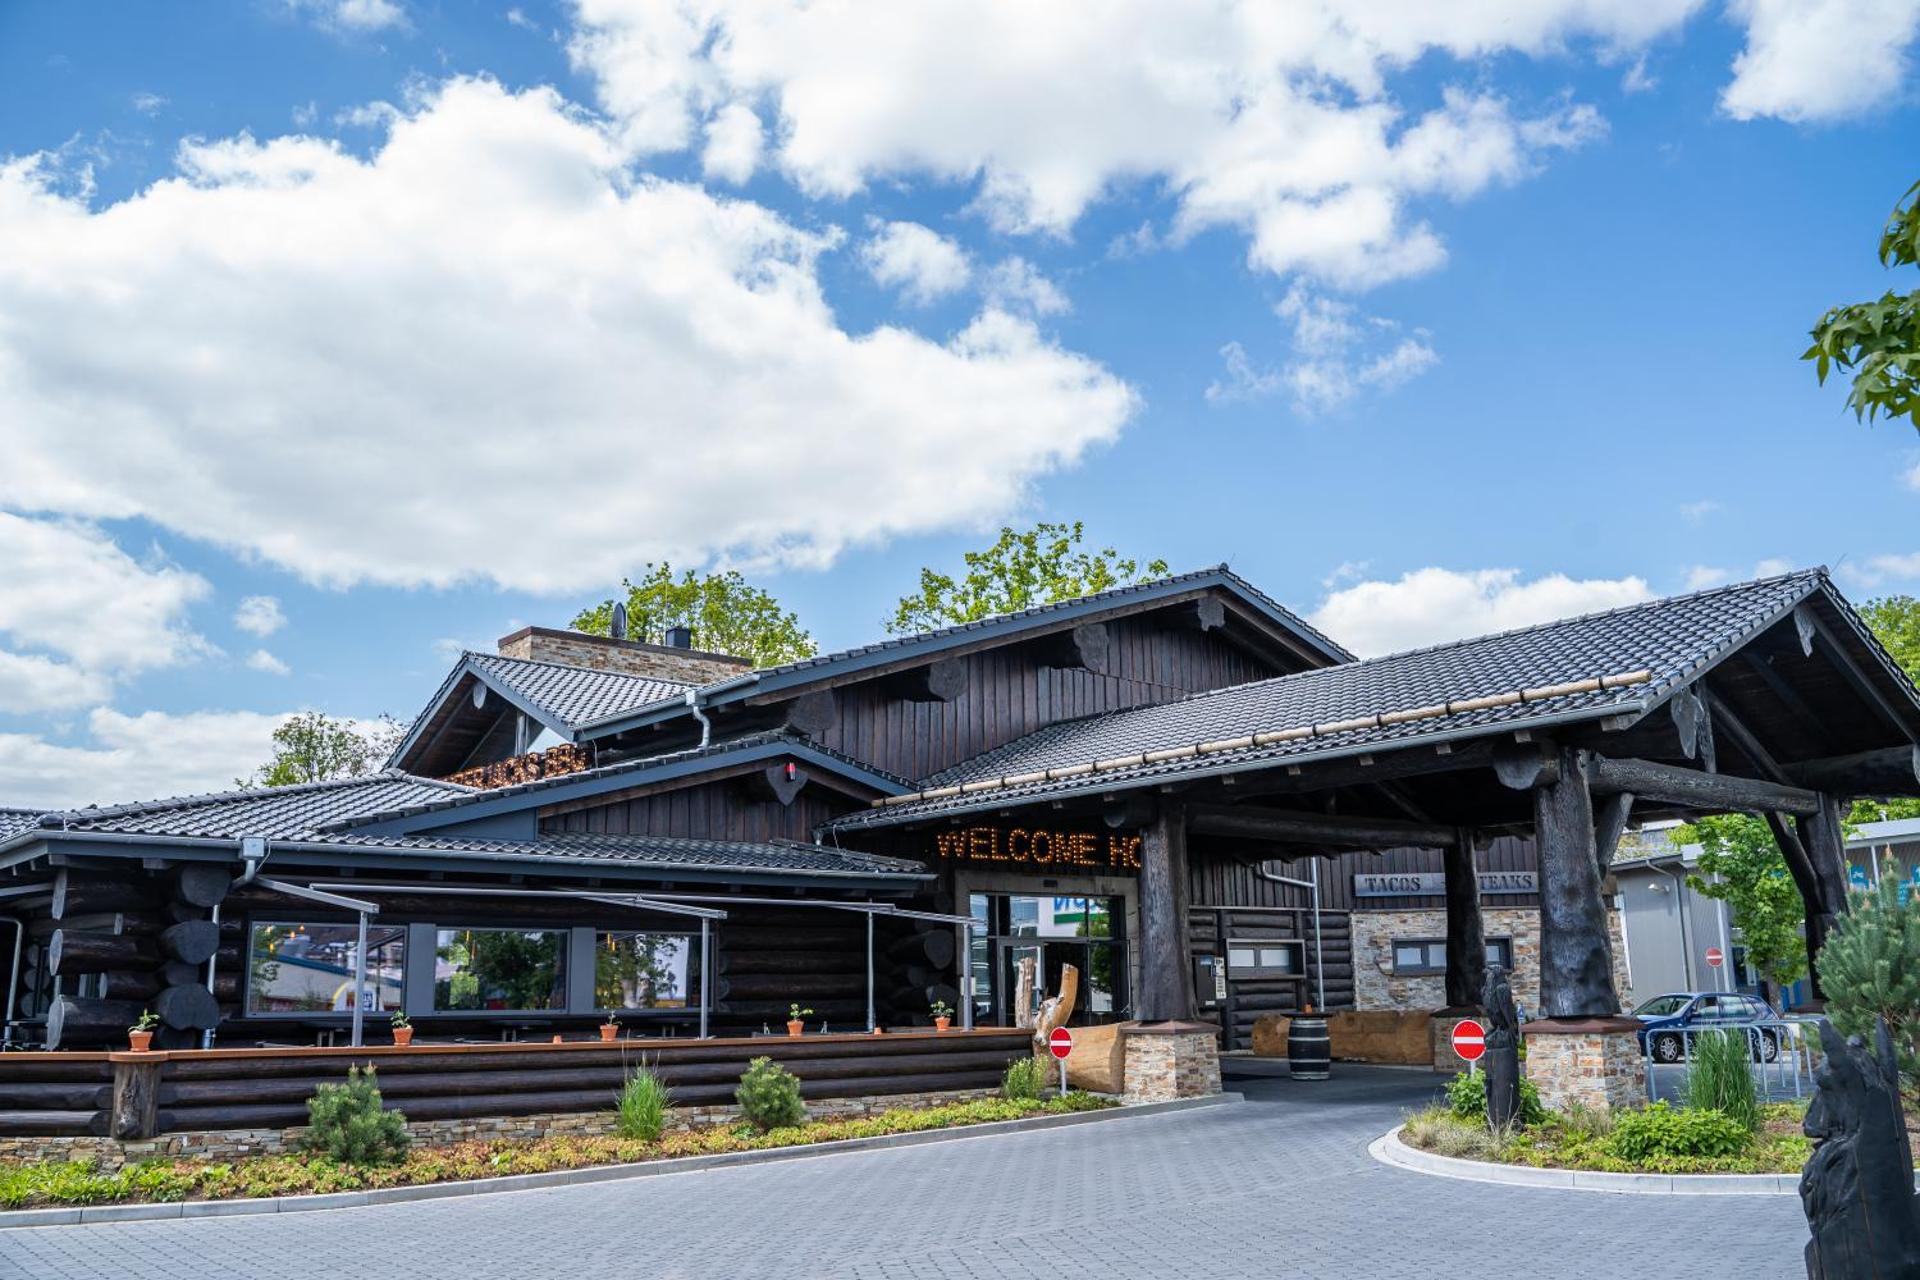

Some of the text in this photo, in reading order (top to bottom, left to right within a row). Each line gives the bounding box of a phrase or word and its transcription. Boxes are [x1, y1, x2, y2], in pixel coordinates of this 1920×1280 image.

[937, 827, 1141, 868] WELCOME HO
[1364, 874, 1533, 893] TACOS TEAKS
